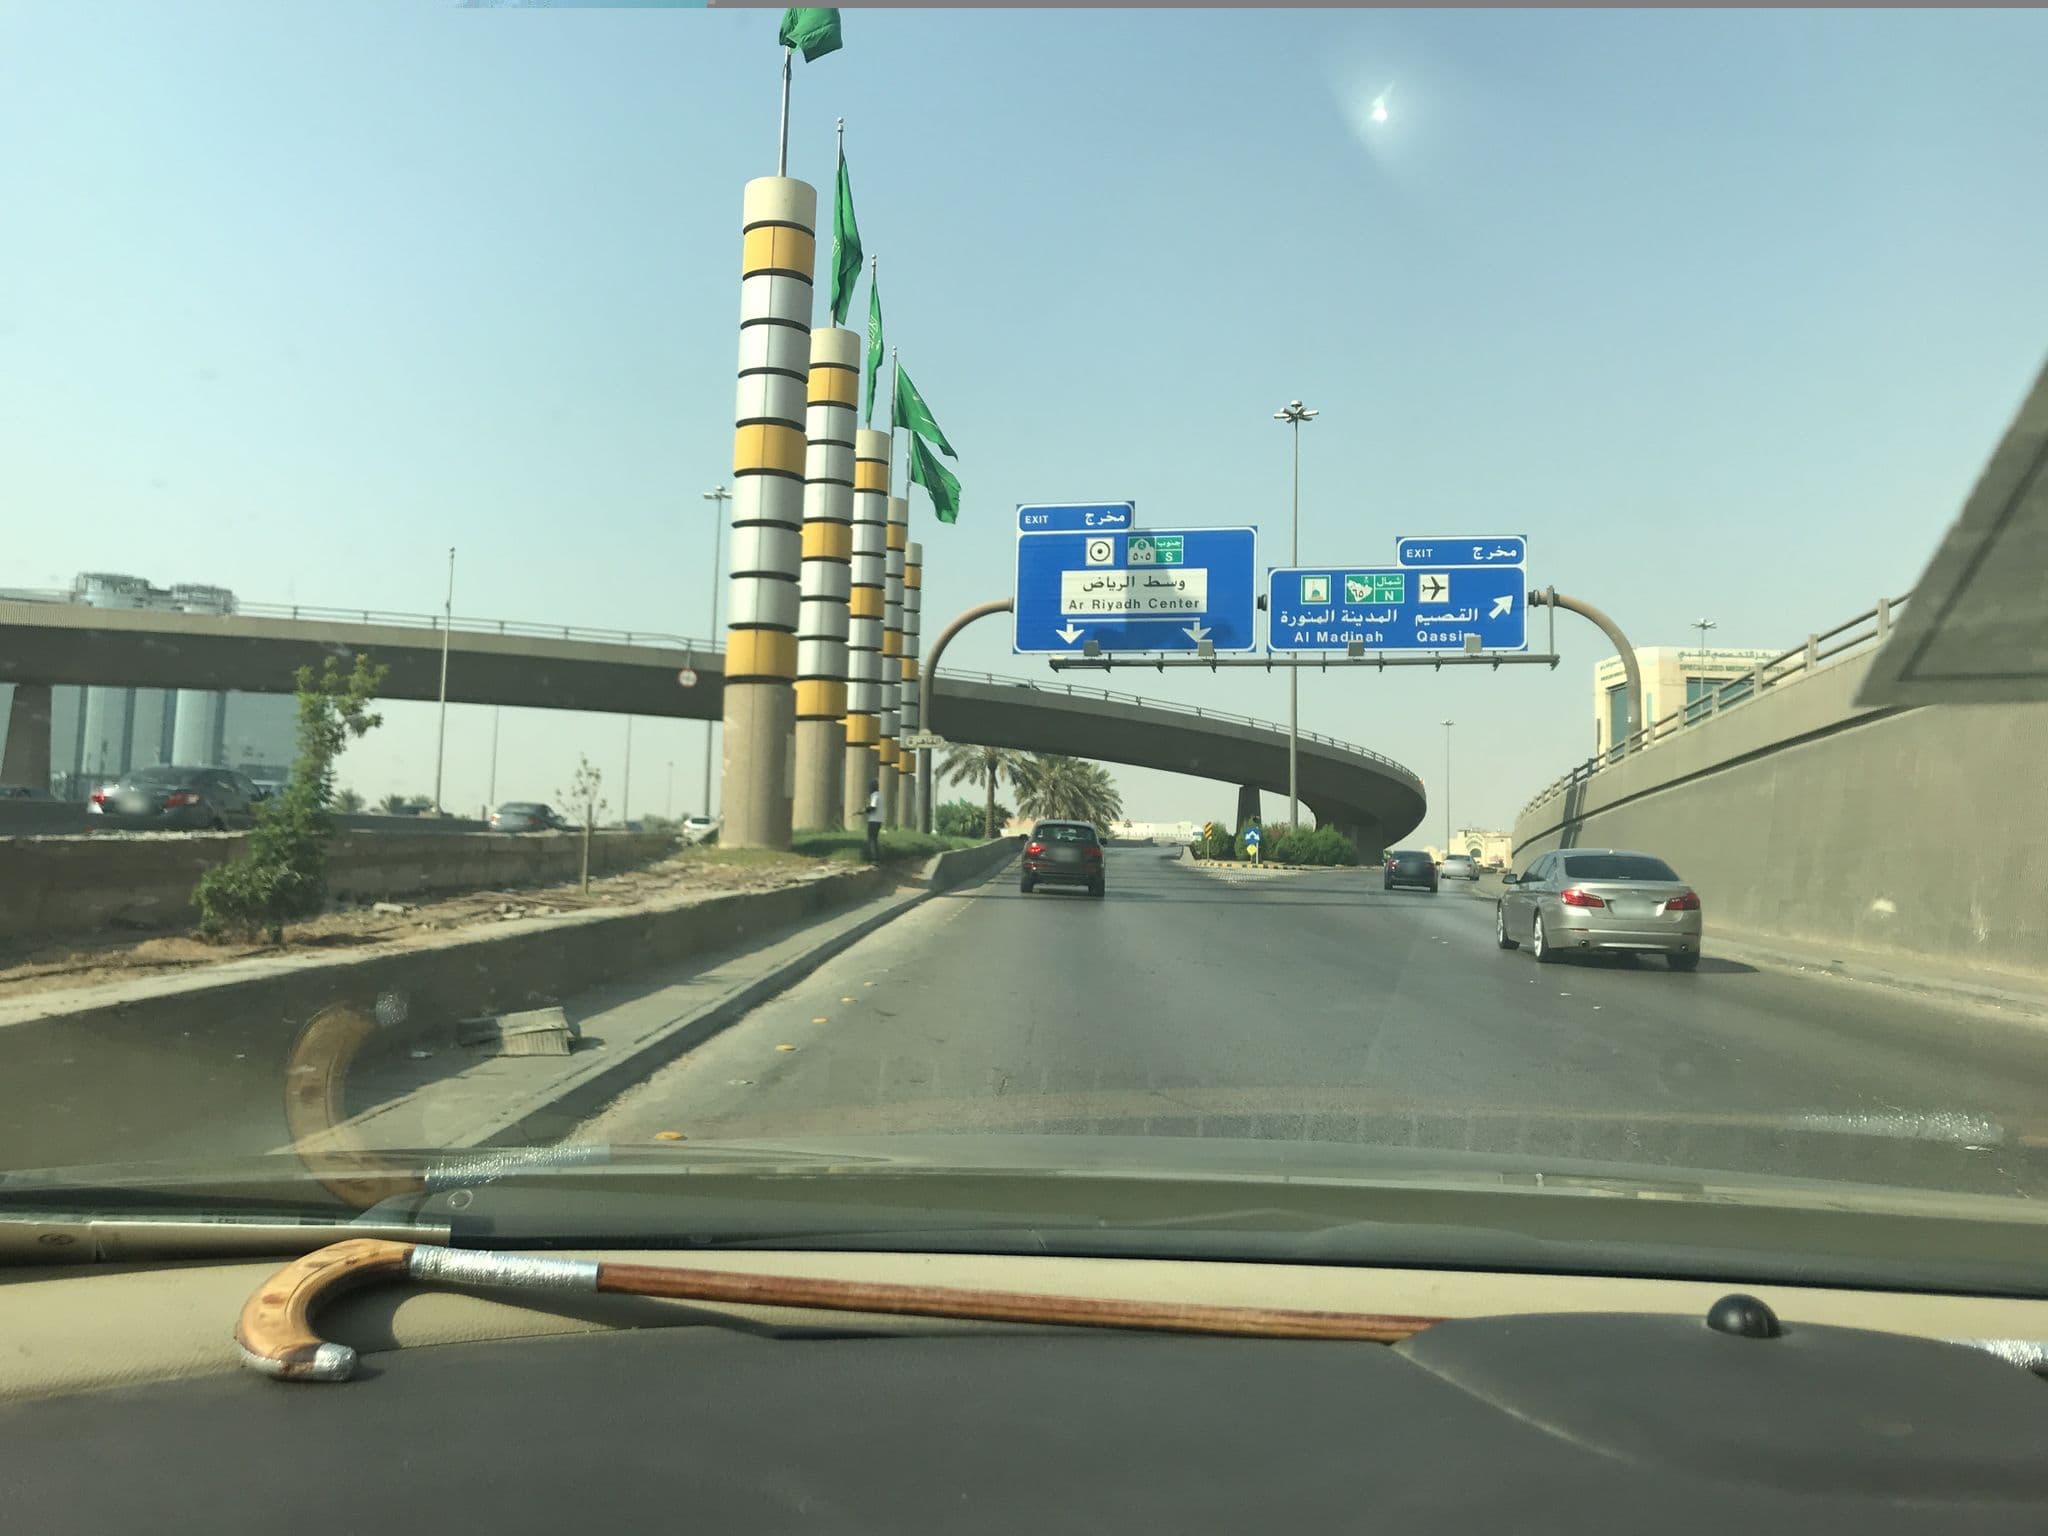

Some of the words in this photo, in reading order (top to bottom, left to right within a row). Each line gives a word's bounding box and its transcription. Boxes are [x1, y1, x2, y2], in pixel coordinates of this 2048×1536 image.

[1025, 515, 1048, 524] EXIT
[1085, 510, 1125, 525] مخرج
[1157, 540, 1181, 548] جنوب
[1133, 552, 1151, 561] ٥٠٥
[1165, 552, 1173, 562] S
[1406, 549, 1433, 558] EXIT
[1472, 545, 1517, 560] مخرج
[1083, 575, 1135, 592] الرياض
[1143, 575, 1186, 591] وسط
[1376, 576, 1402, 587] شمال
[1384, 591, 1394, 601] N
[1069, 599, 1084, 610] Ar
[1092, 598, 1141, 612] Riyadh
[1148, 598, 1200, 609] Center
[1280, 609, 1335, 626] المنورة
[1341, 608, 1398, 626] المدينة
[1415, 608, 1478, 627] القصيم
[1294, 631, 1309, 643] Al
[1317, 630, 1384, 643] Madinah
[1416, 630, 1476, 642] Qassi
